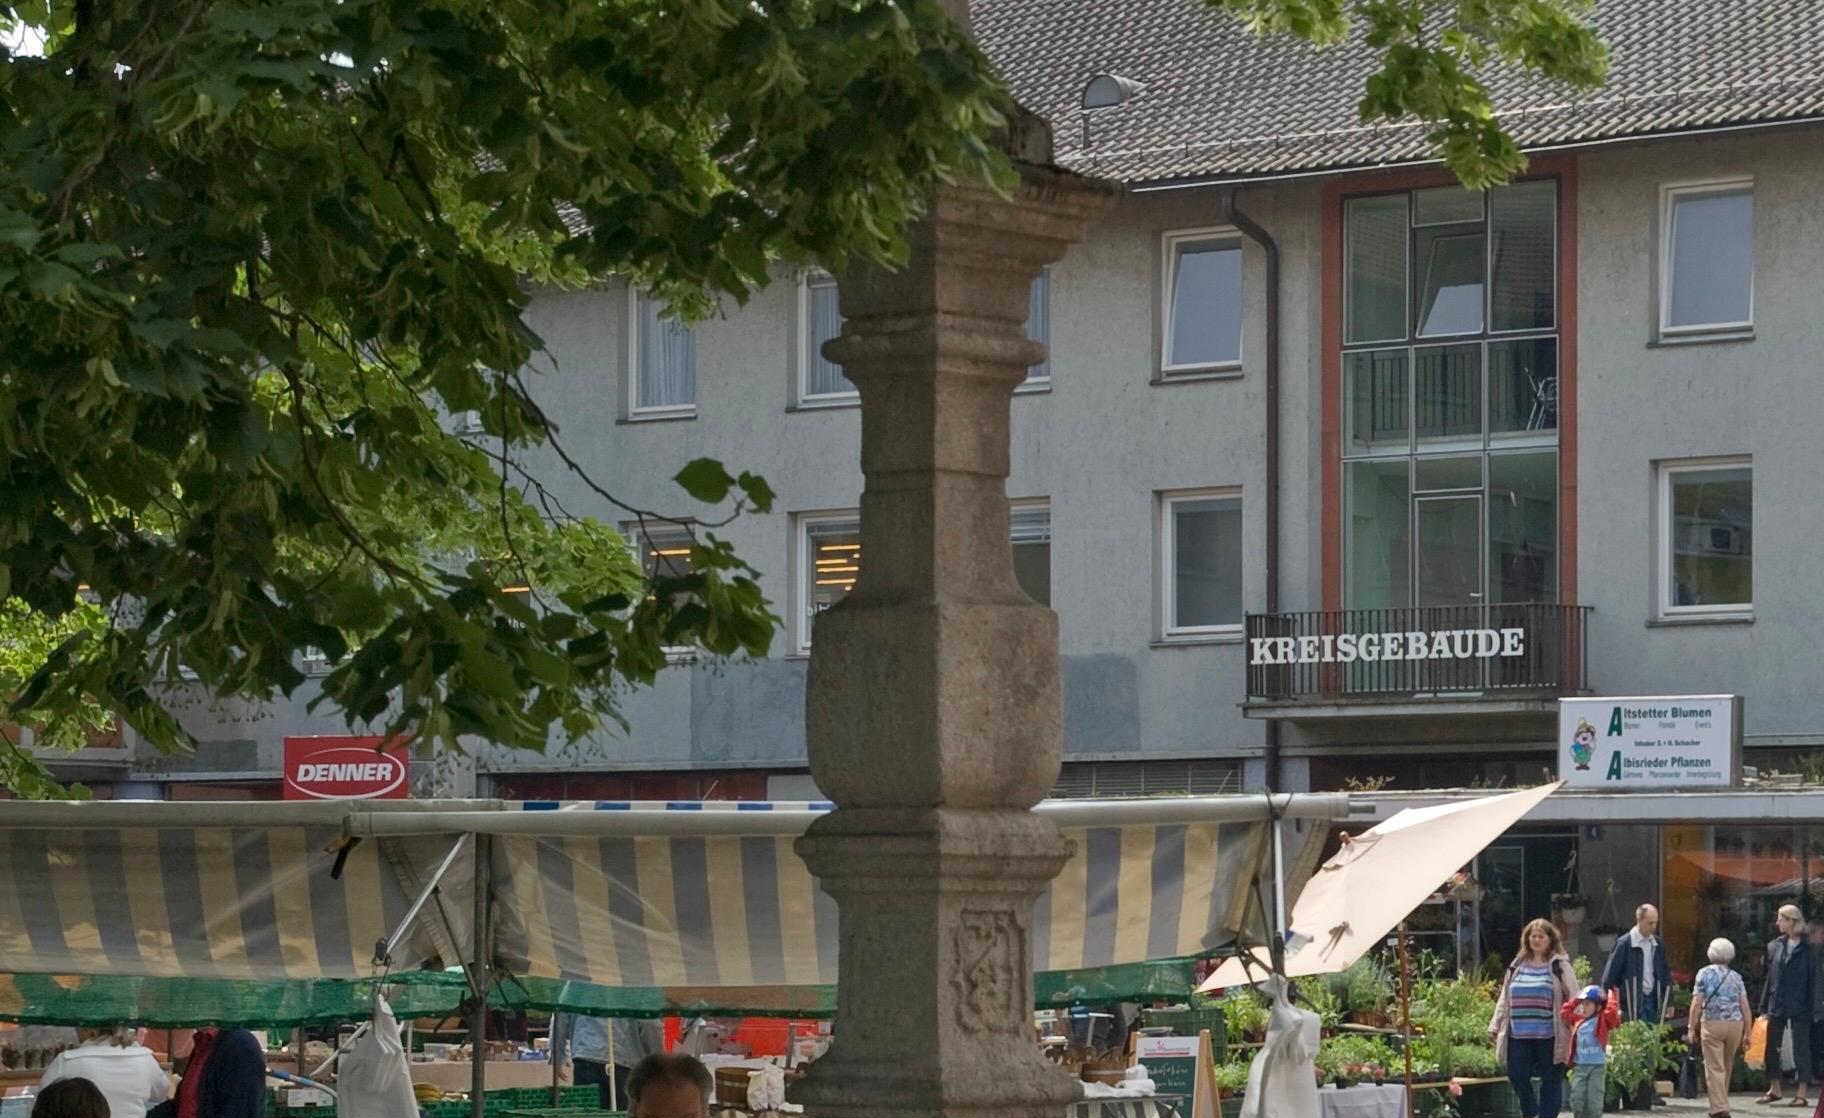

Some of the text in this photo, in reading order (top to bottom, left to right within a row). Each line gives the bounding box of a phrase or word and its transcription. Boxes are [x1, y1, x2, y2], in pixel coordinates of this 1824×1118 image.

[1250, 628, 1524, 665] KREISGEBÄUDE
[1671, 707, 1712, 718] Blumen
[1671, 757, 1711, 768] Pflanzen
[297, 763, 393, 782] DENNER
